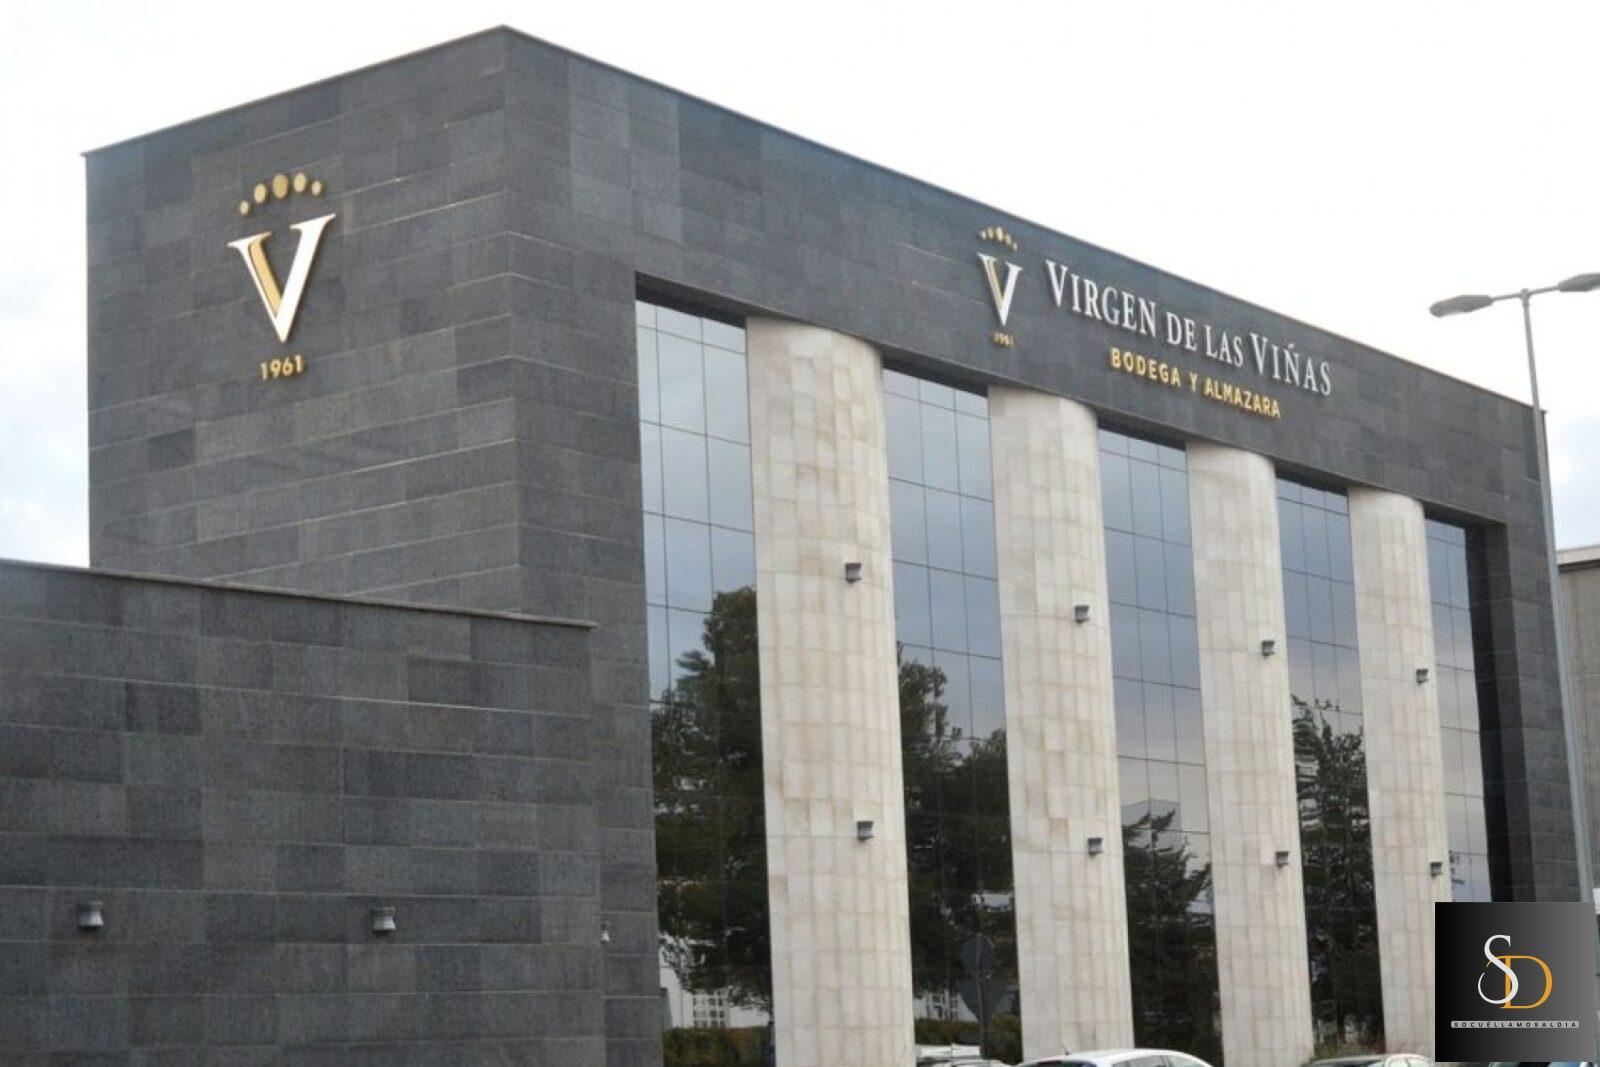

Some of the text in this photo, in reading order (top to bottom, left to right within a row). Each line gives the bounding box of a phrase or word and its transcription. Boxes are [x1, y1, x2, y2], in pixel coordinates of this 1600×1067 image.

[1045, 259, 1333, 396] VIRGEN DE LAS VIÑAS
[259, 354, 304, 381] 1961
[1110, 347, 1282, 420] BODEGA Y ALMAZARA
